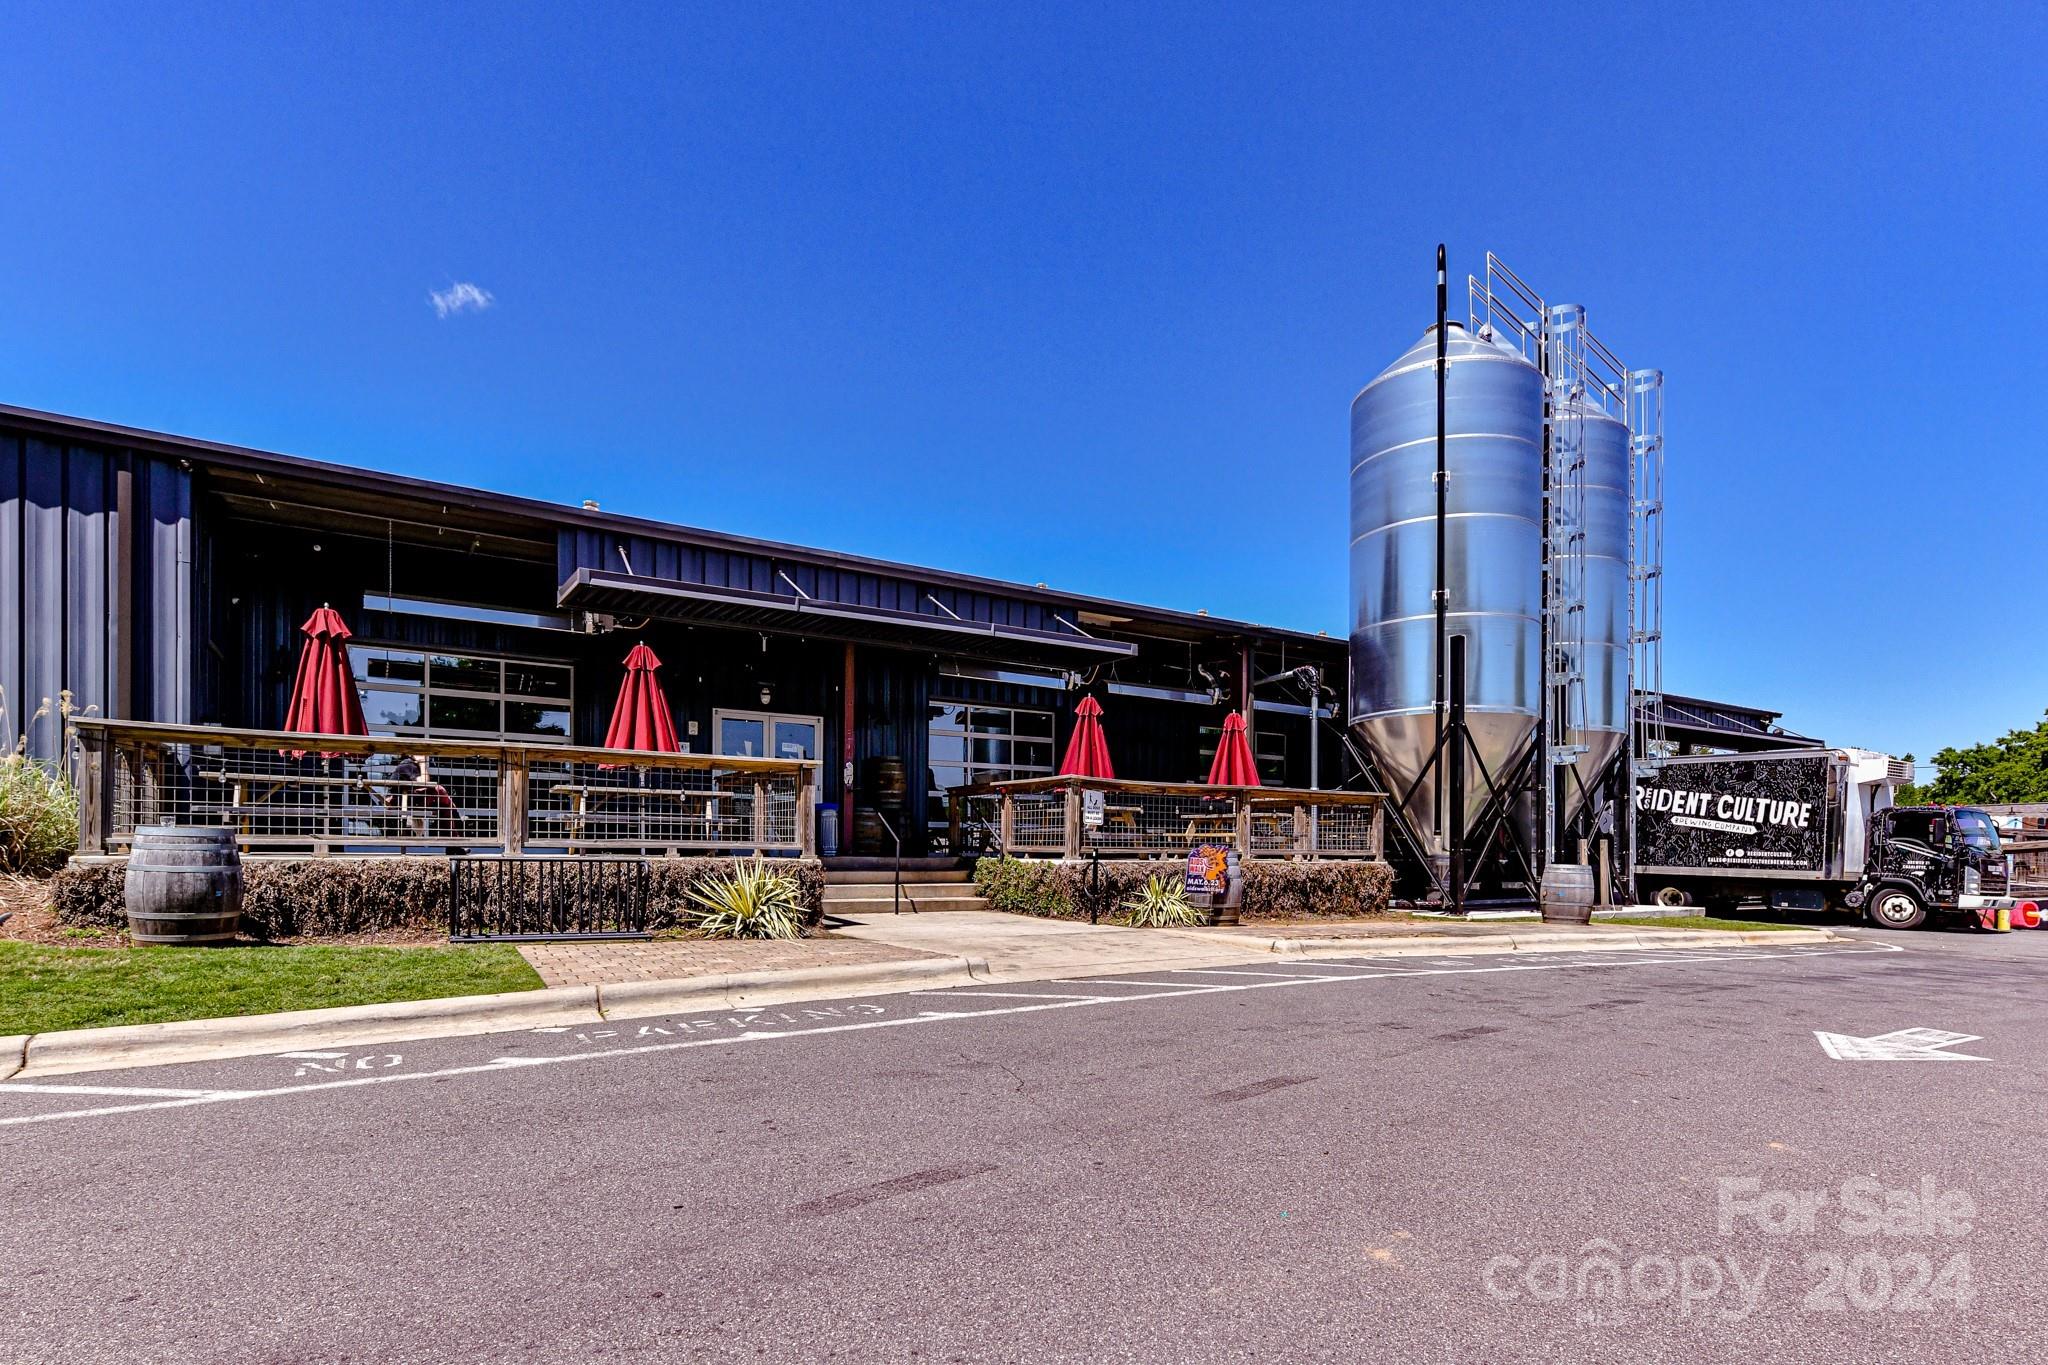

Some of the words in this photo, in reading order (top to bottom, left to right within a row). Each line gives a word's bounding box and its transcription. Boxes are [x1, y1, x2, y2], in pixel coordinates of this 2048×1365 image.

[1675, 817, 1712, 827] BREWING
[1715, 822, 1752, 833] COMPANY
[1717, 794, 1812, 829] CULTURE
[294, 1055, 402, 1076] NO
[576, 1004, 885, 1043] PARKING
